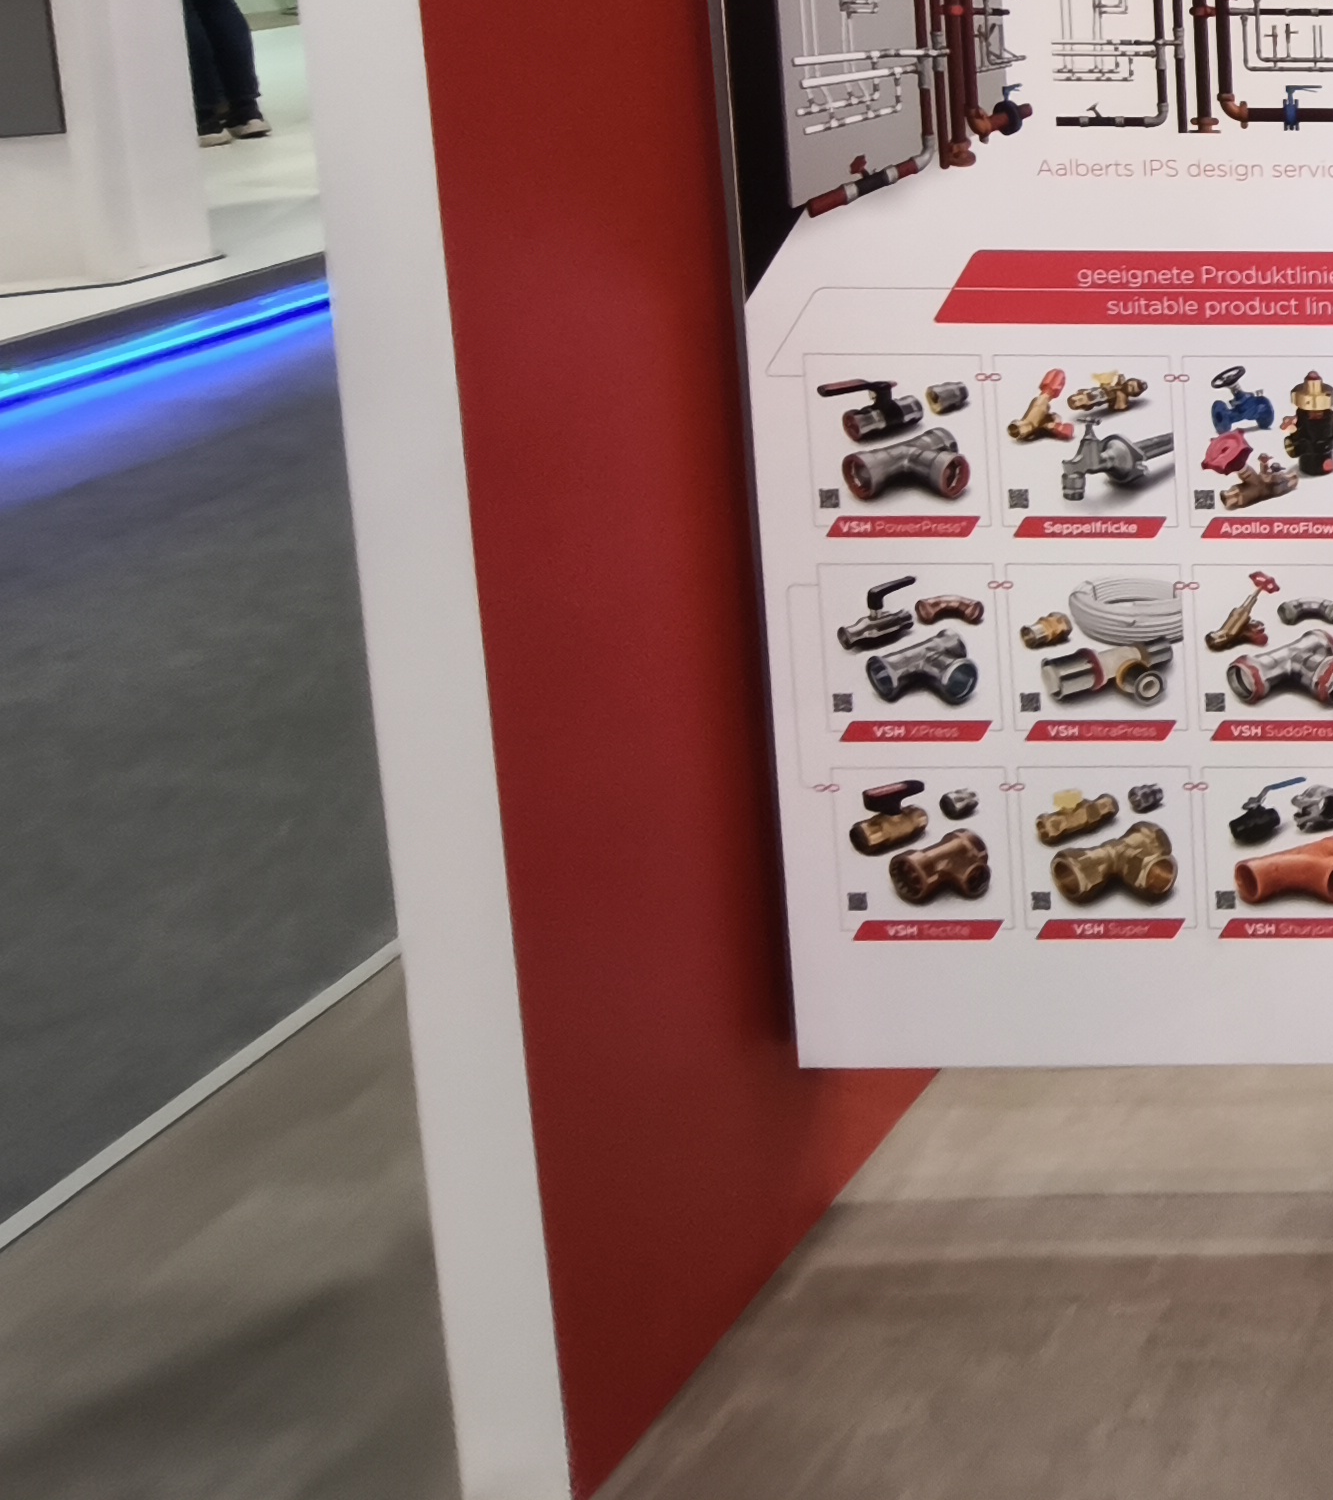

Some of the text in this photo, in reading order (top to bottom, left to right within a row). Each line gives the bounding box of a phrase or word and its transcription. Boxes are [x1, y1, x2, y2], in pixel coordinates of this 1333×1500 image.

[1037, 159, 1134, 177] Aalberts
[1143, 159, 1179, 177] IPS
[1187, 160, 1264, 181] design
[1077, 266, 1194, 286] geeignete
[1107, 296, 1198, 315] suitable
[1205, 298, 1299, 318] product
[839, 521, 872, 533] VSH
[1043, 521, 1138, 535] Seppelfricke
[1220, 521, 1269, 536] Apollo
[873, 725, 905, 737] VSH
[1047, 724, 1078, 737] VSH
[1230, 724, 1262, 737] VSH
[887, 924, 918, 936] VSH
[1074, 923, 1149, 937] VSH Super
[1244, 923, 1275, 935] VSH
